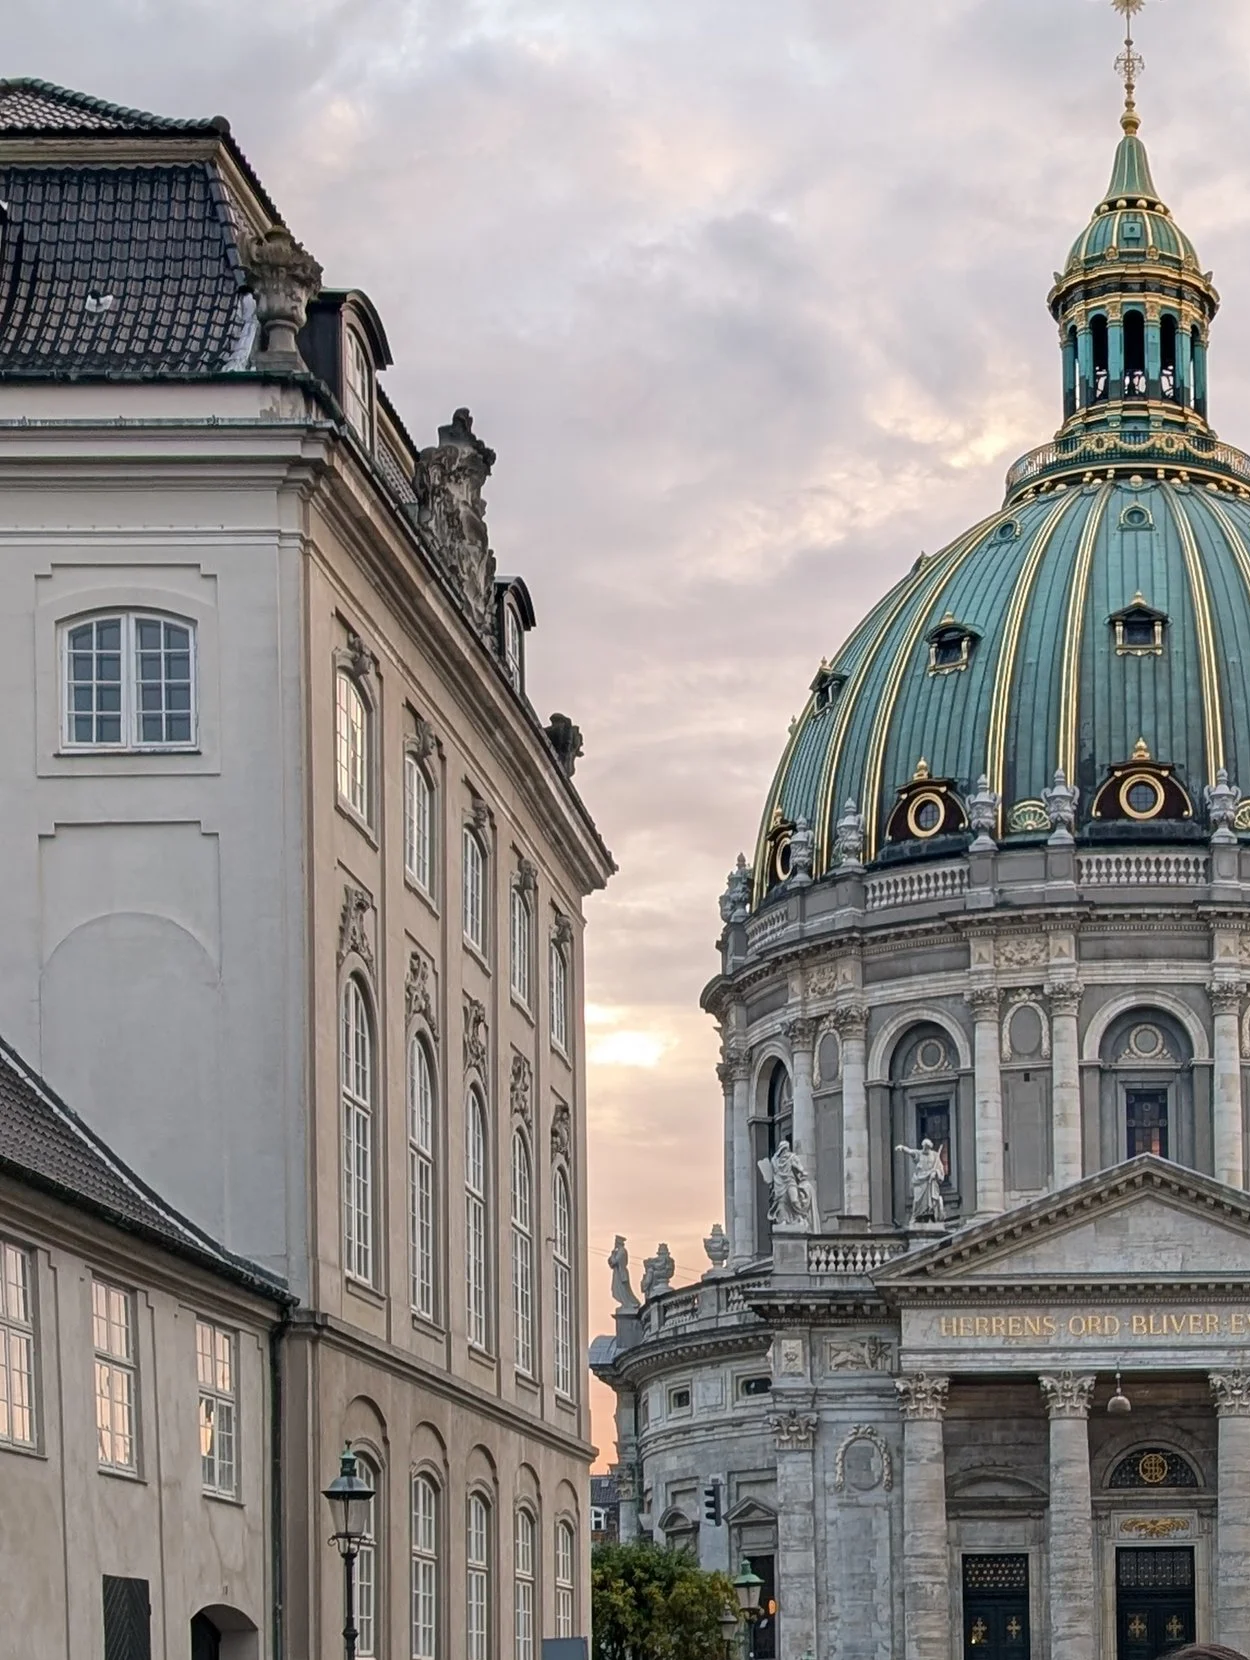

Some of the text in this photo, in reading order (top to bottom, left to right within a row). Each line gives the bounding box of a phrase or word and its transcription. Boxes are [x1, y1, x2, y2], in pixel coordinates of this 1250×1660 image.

[940, 1315, 1057, 1338] HERRENS
[1068, 1314, 1121, 1337] ORD
[1131, 1313, 1221, 1335] BLIVER
